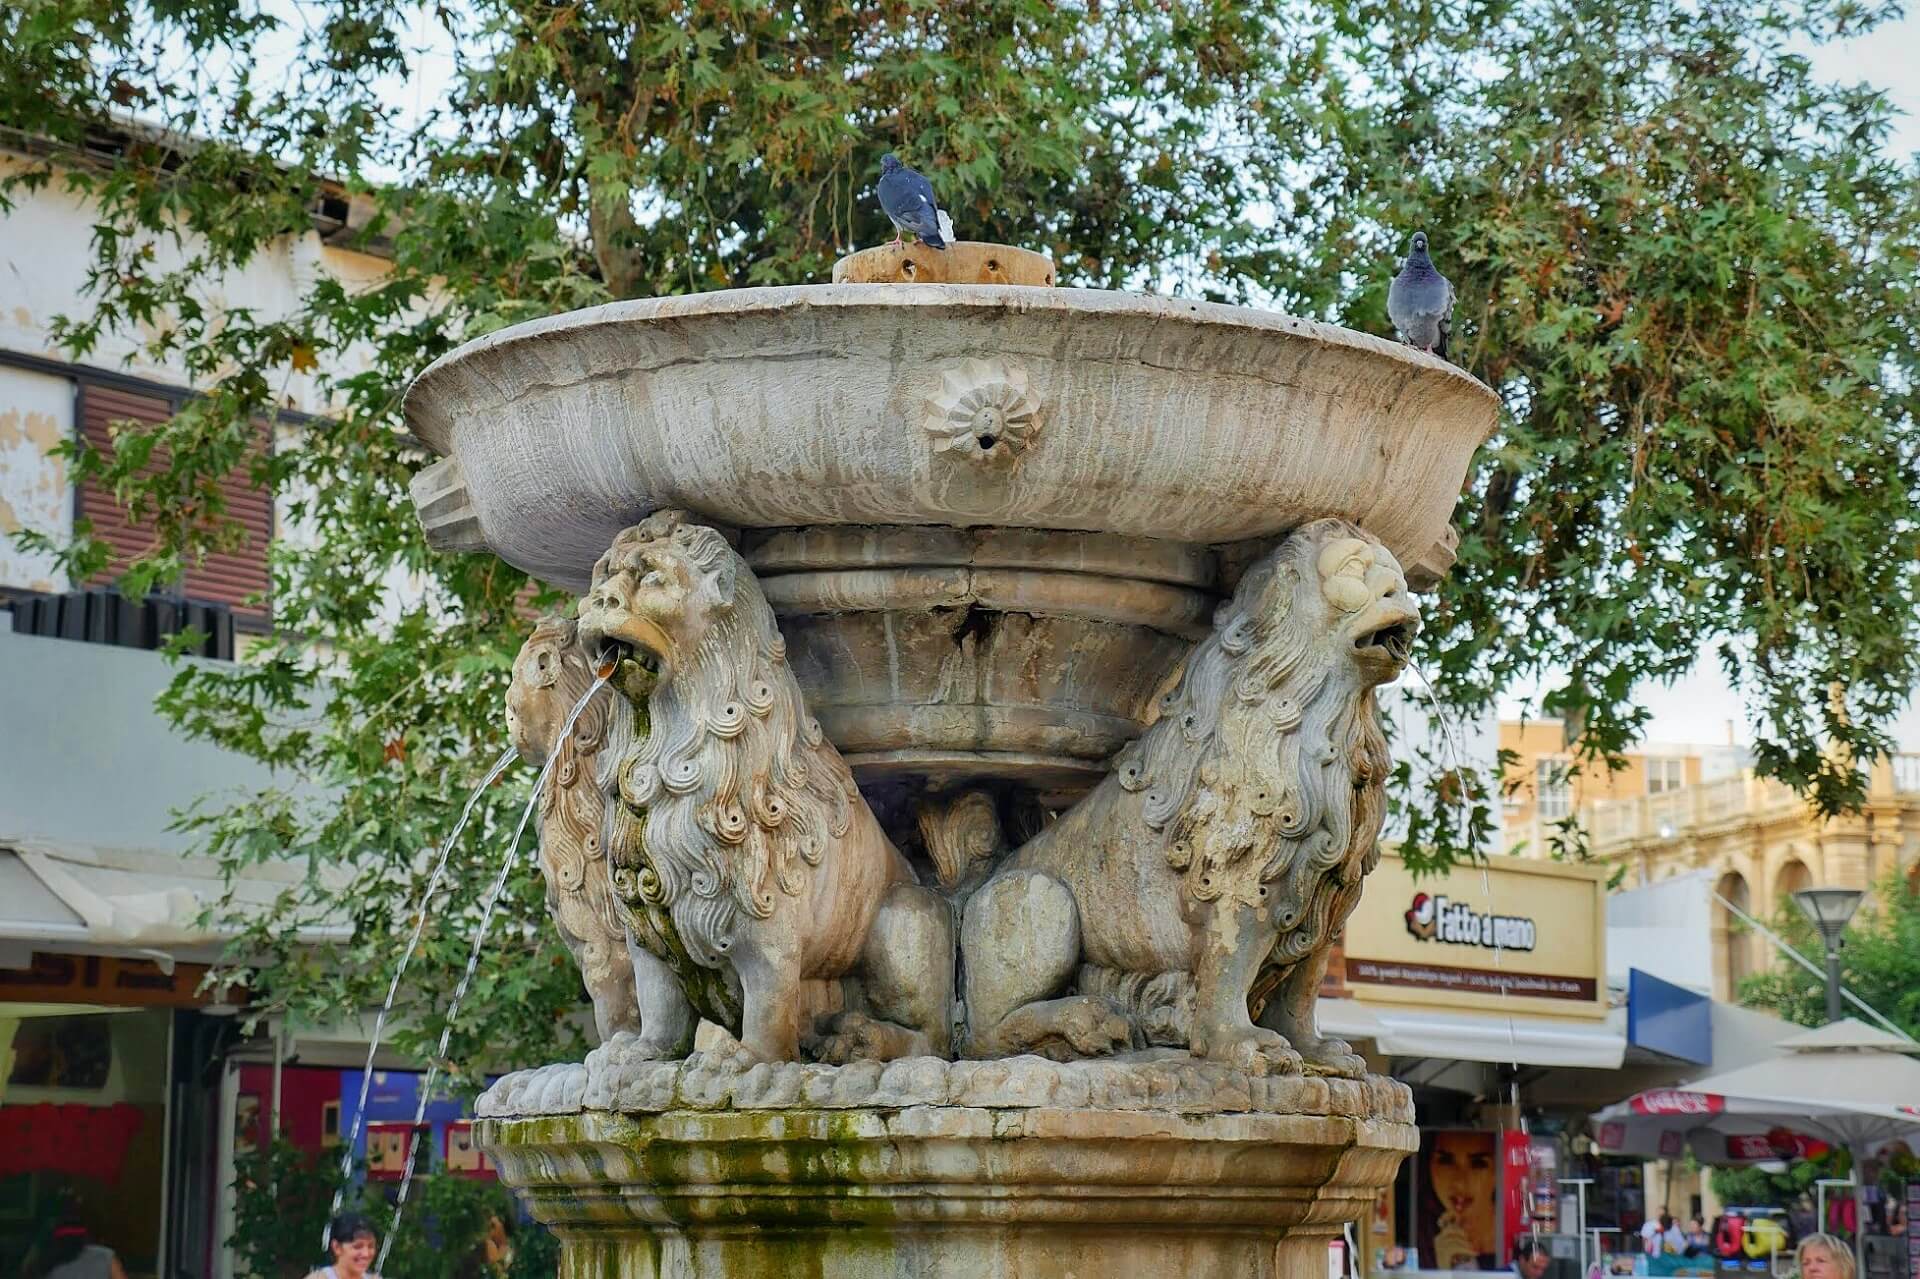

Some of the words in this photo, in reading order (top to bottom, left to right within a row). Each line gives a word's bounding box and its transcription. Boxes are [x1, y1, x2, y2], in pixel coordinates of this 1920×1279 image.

[1435, 896, 1481, 945] Fatto
[1482, 914, 1493, 947] a
[1493, 917, 1536, 950] mano
